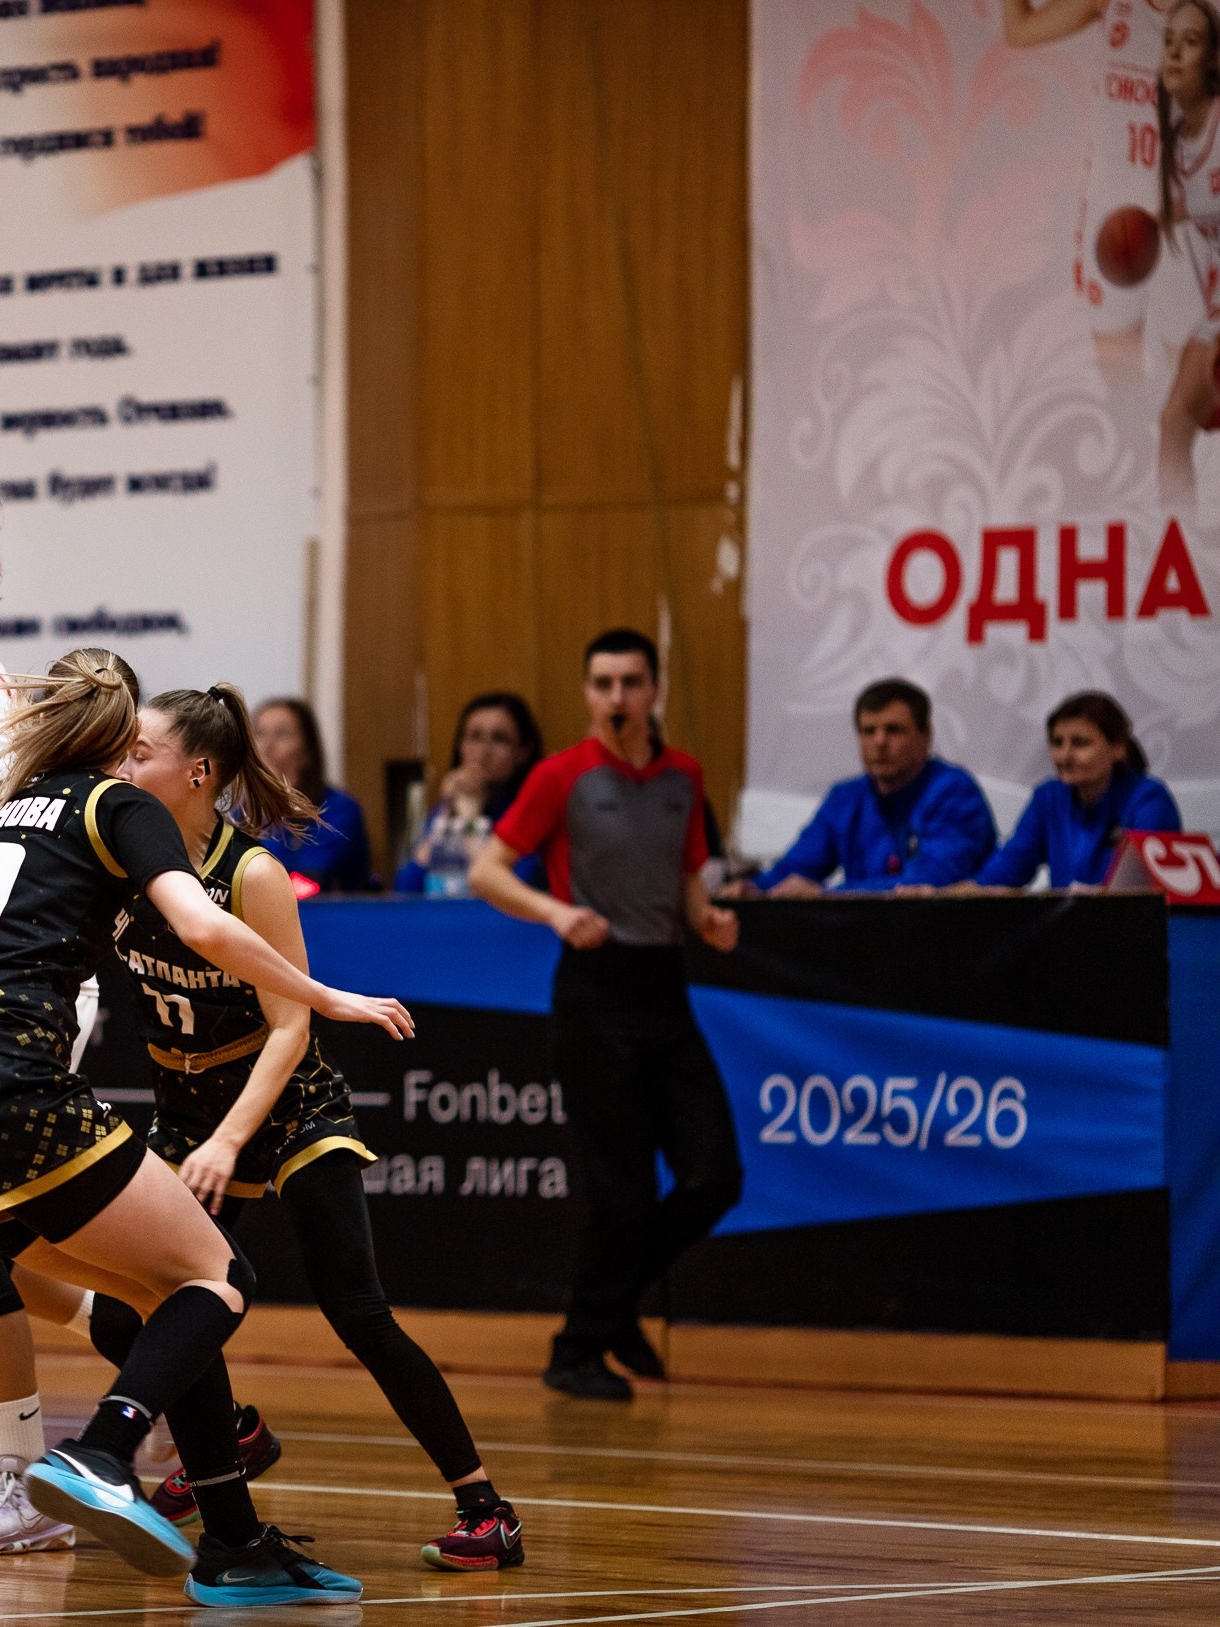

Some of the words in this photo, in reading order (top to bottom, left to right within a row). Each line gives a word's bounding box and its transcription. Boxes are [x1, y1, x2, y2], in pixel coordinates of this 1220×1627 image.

[887, 516, 1213, 647] ОДНА
[759, 1071, 1028, 1151] 2025/26
[459, 1155, 569, 1199] лига
